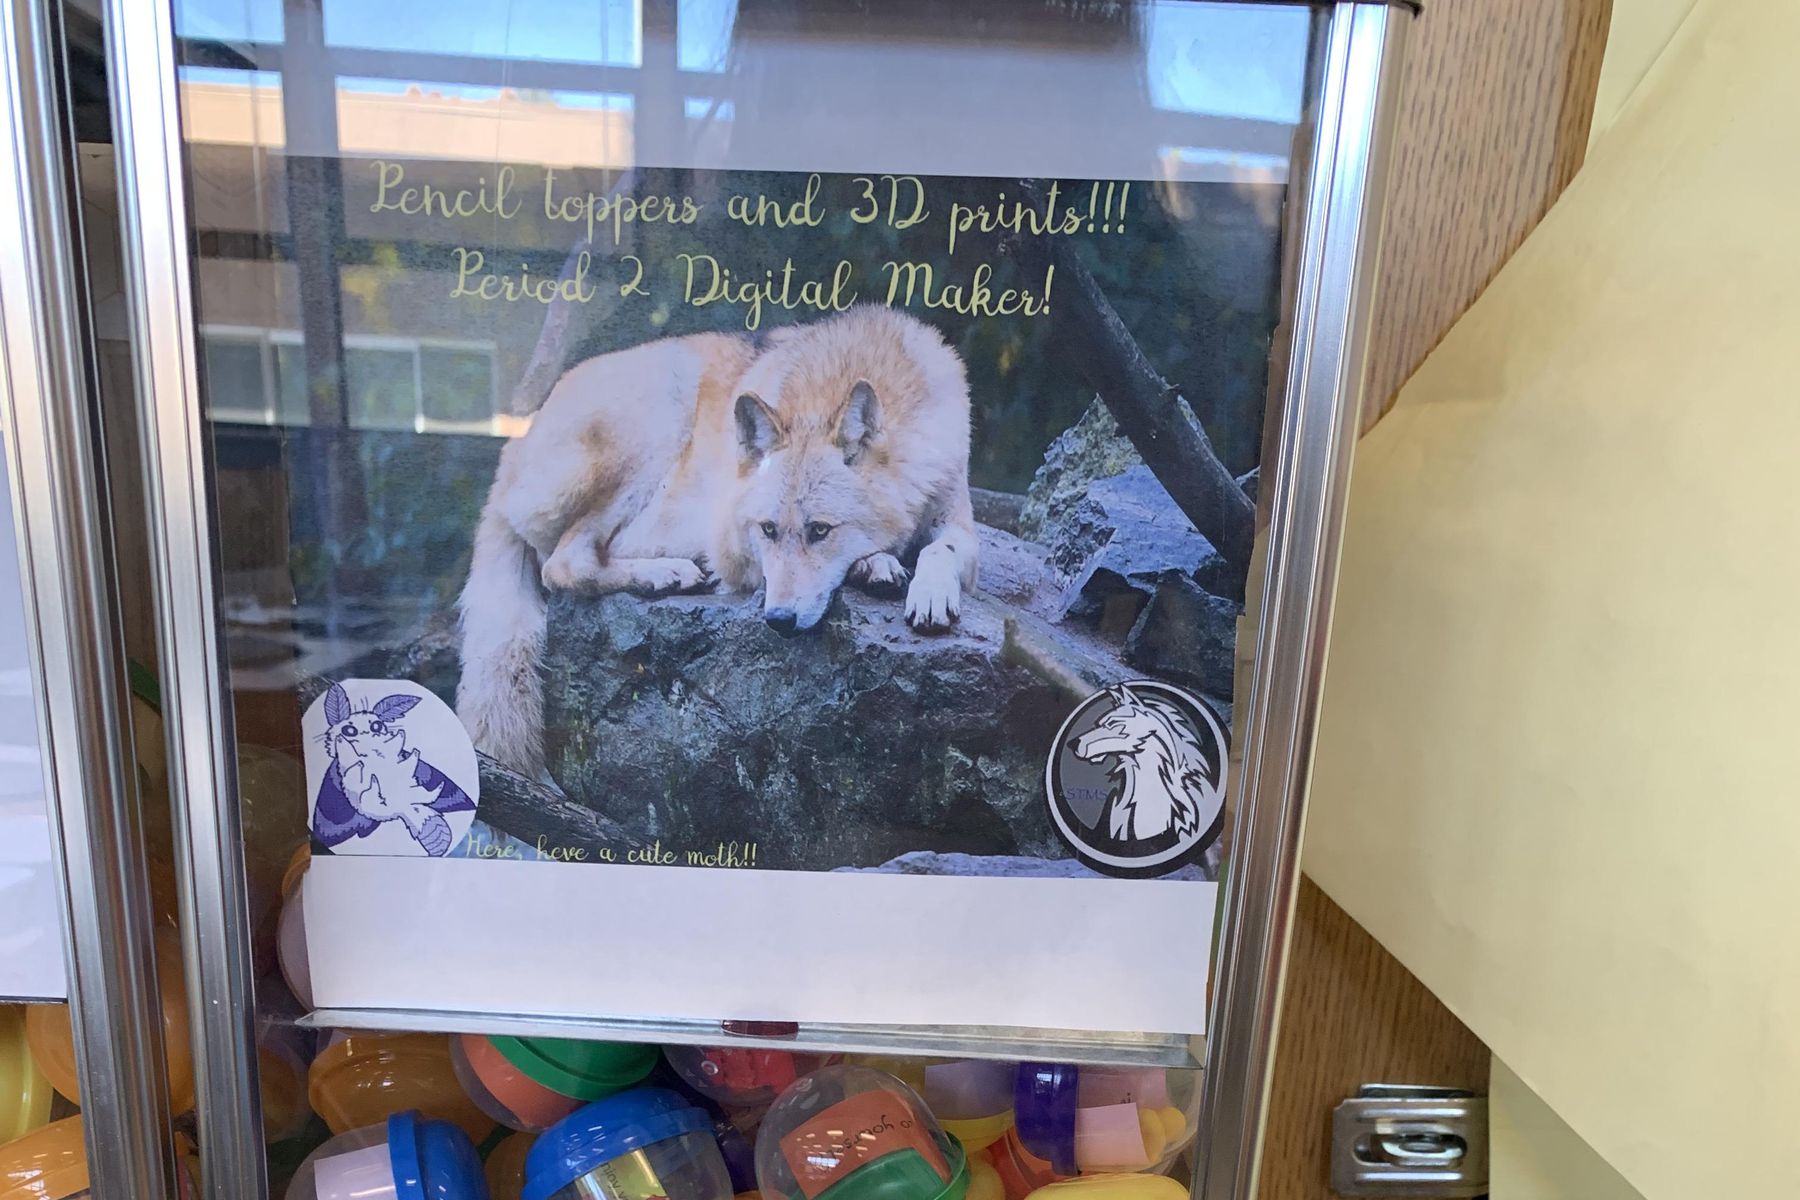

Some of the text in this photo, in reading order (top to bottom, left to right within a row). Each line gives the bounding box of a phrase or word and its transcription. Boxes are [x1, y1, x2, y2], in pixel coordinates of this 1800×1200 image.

[369, 159, 1131, 255] Pencil toppers and 3D prints!!!
[450, 247, 1055, 331] Period 2 Digital Maker!
[465, 832, 523, 861] Here,
[599, 846, 617, 863] a
[627, 839, 678, 866] cute
[686, 840, 757, 868] moth!!
